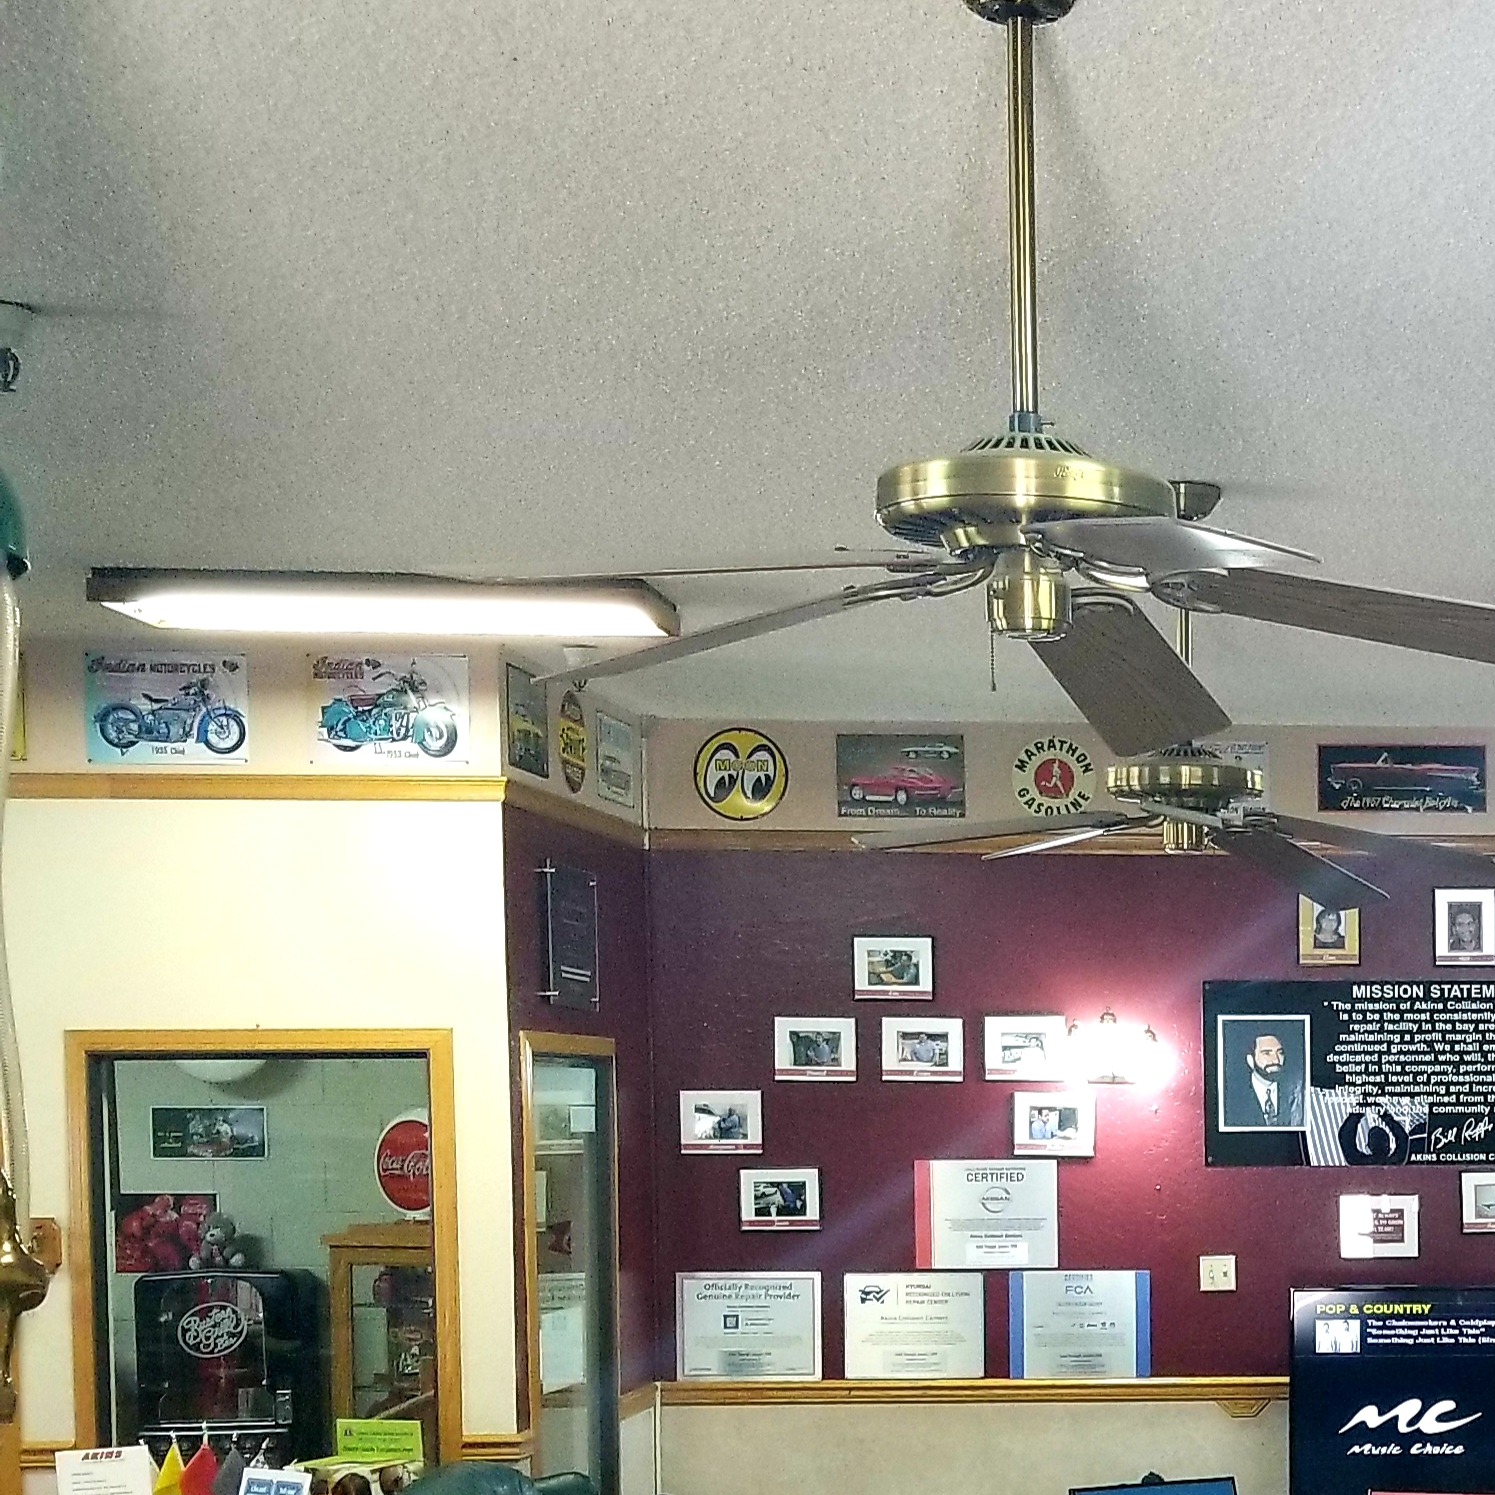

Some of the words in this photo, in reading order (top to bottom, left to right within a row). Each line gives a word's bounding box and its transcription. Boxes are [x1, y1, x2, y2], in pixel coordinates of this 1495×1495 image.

[1014, 738, 1094, 775] MARATHON
[714, 758, 769, 773] MOON
[1017, 787, 1091, 817] GASOLINE
[840, 806, 867, 817] From
[915, 806, 927, 817] To
[928, 806, 962, 818] Reality
[1352, 984, 1424, 999] MISSION
[1331, 1000, 1351, 1011] The
[1354, 1000, 1397, 1011] mission
[1399, 1000, 1411, 1011] of
[1413, 1000, 1444, 1011] Akins
[1446, 1000, 1493, 1011] Collision
[1352, 1011, 1363, 1021] to
[1366, 1011, 1380, 1021] be
[1383, 1011, 1400, 1021] the
[1403, 1011, 1430, 1021] most
[1349, 1021, 1380, 1032] repair
[1383, 1021, 1419, 1032] facility
[1422, 1021, 1432, 1031] in
[1435, 1021, 1452, 1031] the
[1455, 1021, 1475, 1032] bay
[1339, 1032, 1400, 1043] maintaining
[1404, 1033, 1411, 1041] a
[1414, 1032, 1442, 1043] profit
[1445, 1032, 1482, 1043] margin
[1335, 1042, 1388, 1052] continued
[1391, 1042, 1431, 1054] growth.
[1434, 1042, 1451, 1052] We
[1454, 1042, 1480, 1052] shall
[1326, 1053, 1378, 1063] dedicated
[1381, 1053, 1435, 1064] personnel
[1438, 1053, 1460, 1063] who
[1463, 1053, 1484, 1064] will,
[1335, 1063, 1365, 1073] belief
[1368, 1063, 1378, 1073] in
[1382, 1063, 1402, 1073] this
[1405, 1063, 1457, 1075] company,
[1410, 1153, 1437, 1162] AKINS
[1439, 1153, 1486, 1162] COLLISION
[379, 1149, 430, 1180] Coca-Col
[966, 1172, 1025, 1183] CERTIFIED
[703, 1282, 742, 1293] Officially
[1065, 1285, 1094, 1295] FCA
[696, 1292, 733, 1301] Genuine
[764, 1292, 801, 1301] Provider
[1316, 1304, 1345, 1315] POP
[1349, 1304, 1359, 1315] &
[1363, 1304, 1432, 1315] COUNTRY
[1436, 1336, 1455, 1345] Like
[1347, 1443, 1403, 1456] Music
[1409, 1442, 1465, 1455] Choice
[81, 1450, 123, 1462] AKINS
